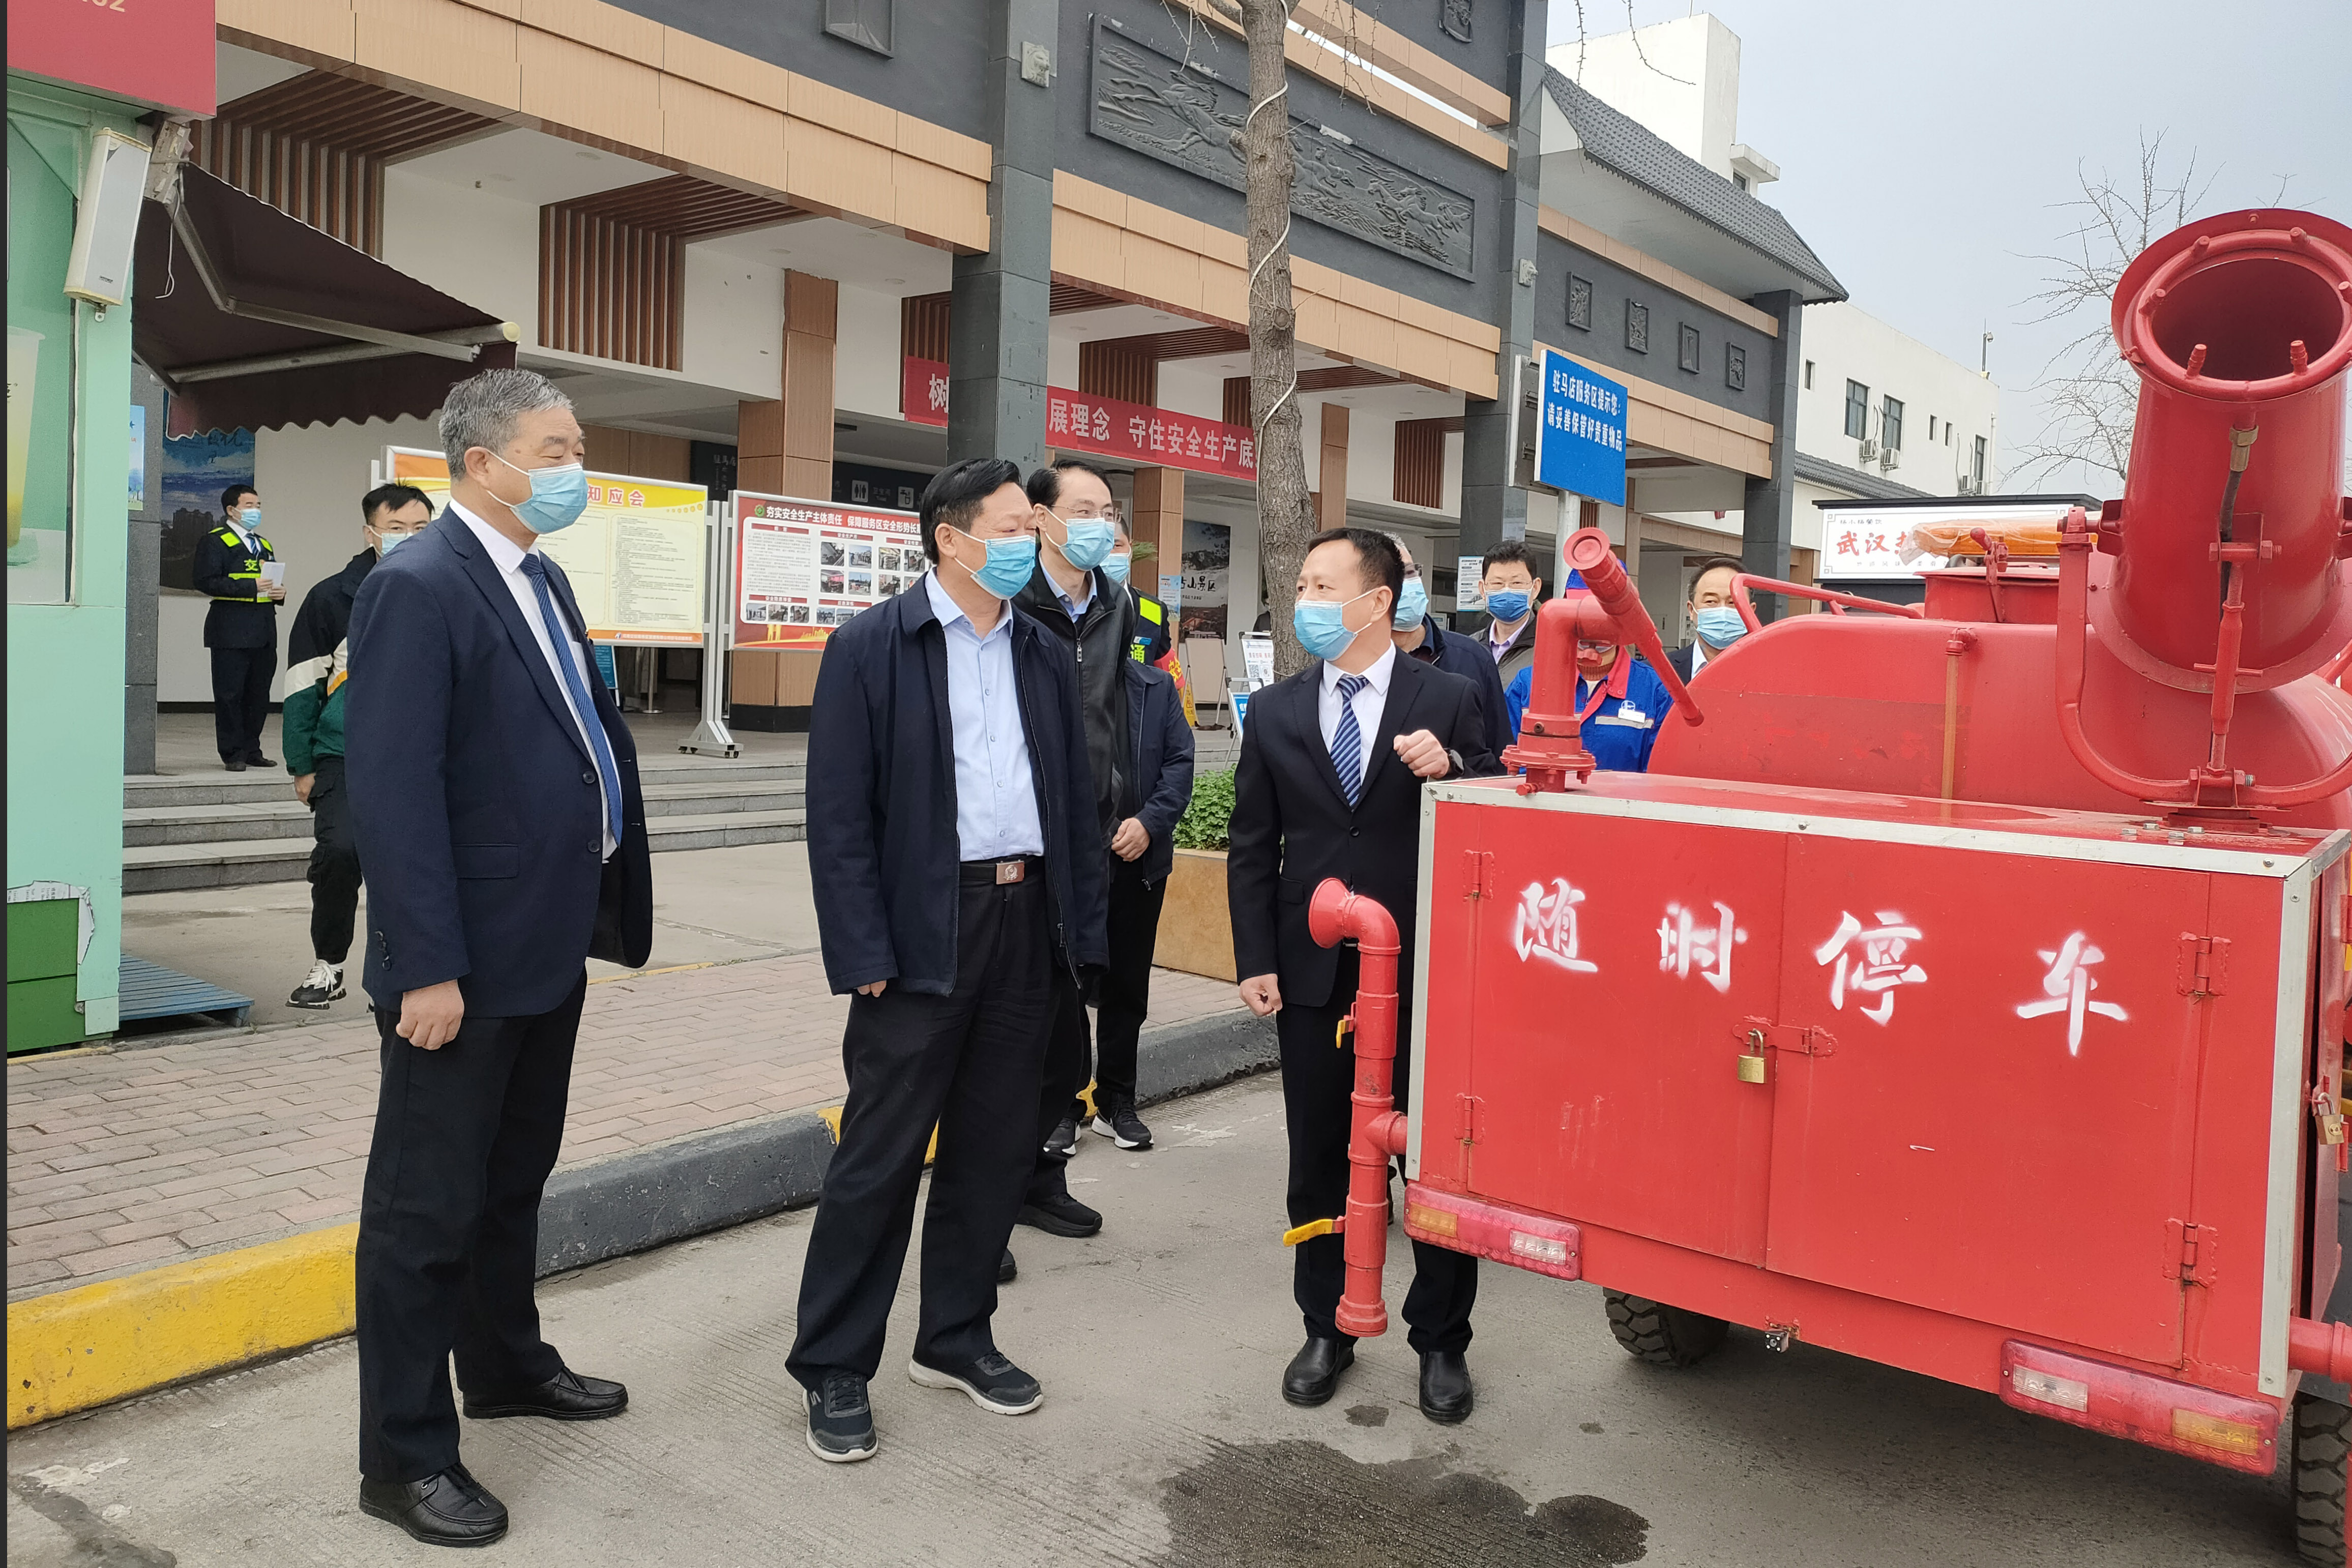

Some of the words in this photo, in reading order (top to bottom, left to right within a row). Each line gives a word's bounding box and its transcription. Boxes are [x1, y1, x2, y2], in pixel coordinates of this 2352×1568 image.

[1049, 398, 1110, 441] 展理念
[1129, 415, 1257, 469] 守住安全生产底
[1548, 402, 1622, 452] 请妥善保管好贵重物品
[587, 485, 644, 507] 知应会
[766, 506, 842, 525] 夯实安全生产主体责任
[1130, 644, 1145, 665] 通
[1514, 876, 2130, 1057] 随时停车
